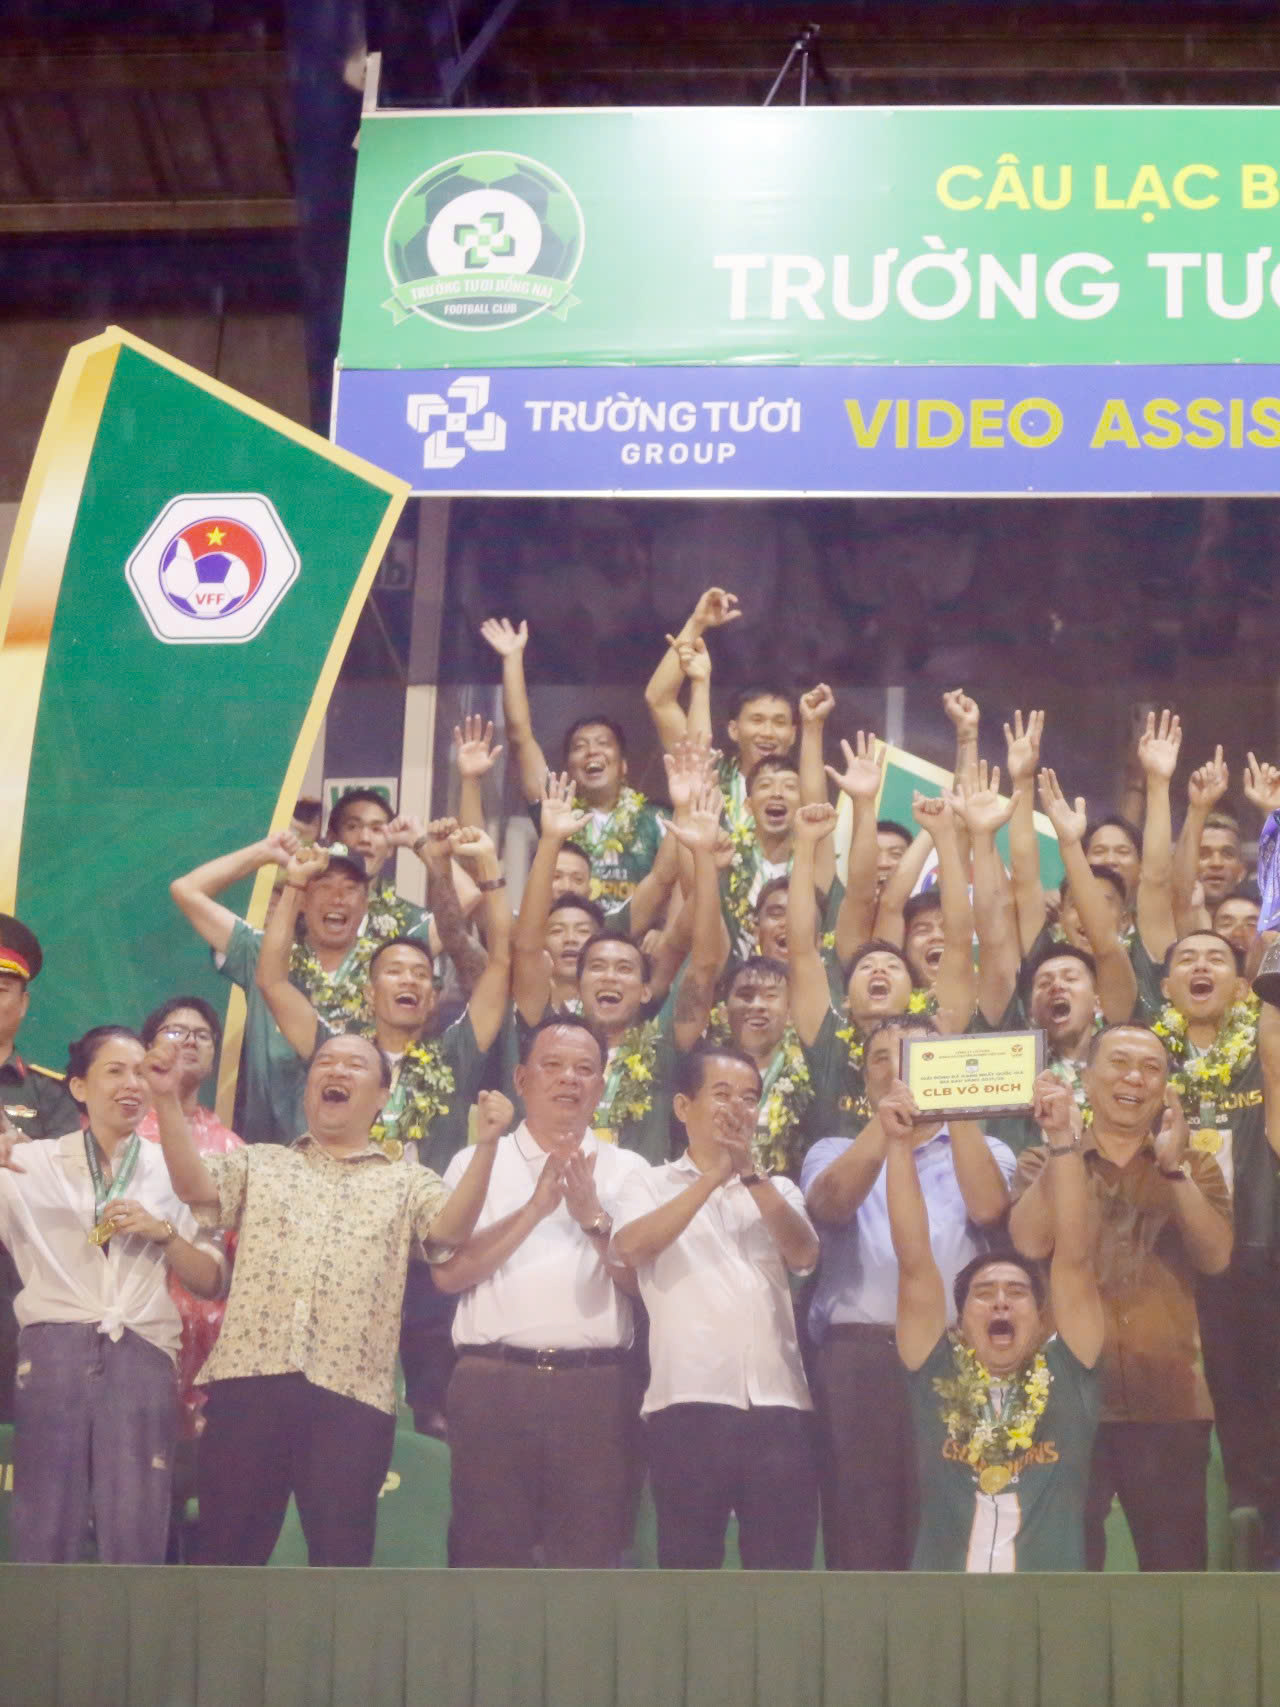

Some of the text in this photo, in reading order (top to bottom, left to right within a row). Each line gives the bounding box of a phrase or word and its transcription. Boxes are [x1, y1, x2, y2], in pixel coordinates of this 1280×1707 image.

[937, 153, 1073, 210] CÂU
[1095, 164, 1221, 223] LẠC
[712, 235, 1121, 321] TRƯỜNG
[444, 303, 517, 315] FOOTBALL CLUB
[524, 392, 801, 433] TRƯỜNG TƯƠI
[845, 398, 1064, 449] VIDEO
[621, 442, 737, 465] GROUP
[195, 592, 225, 606] VFF
[923, 1083, 1021, 1097] CLB VÔ ĐỊCH
